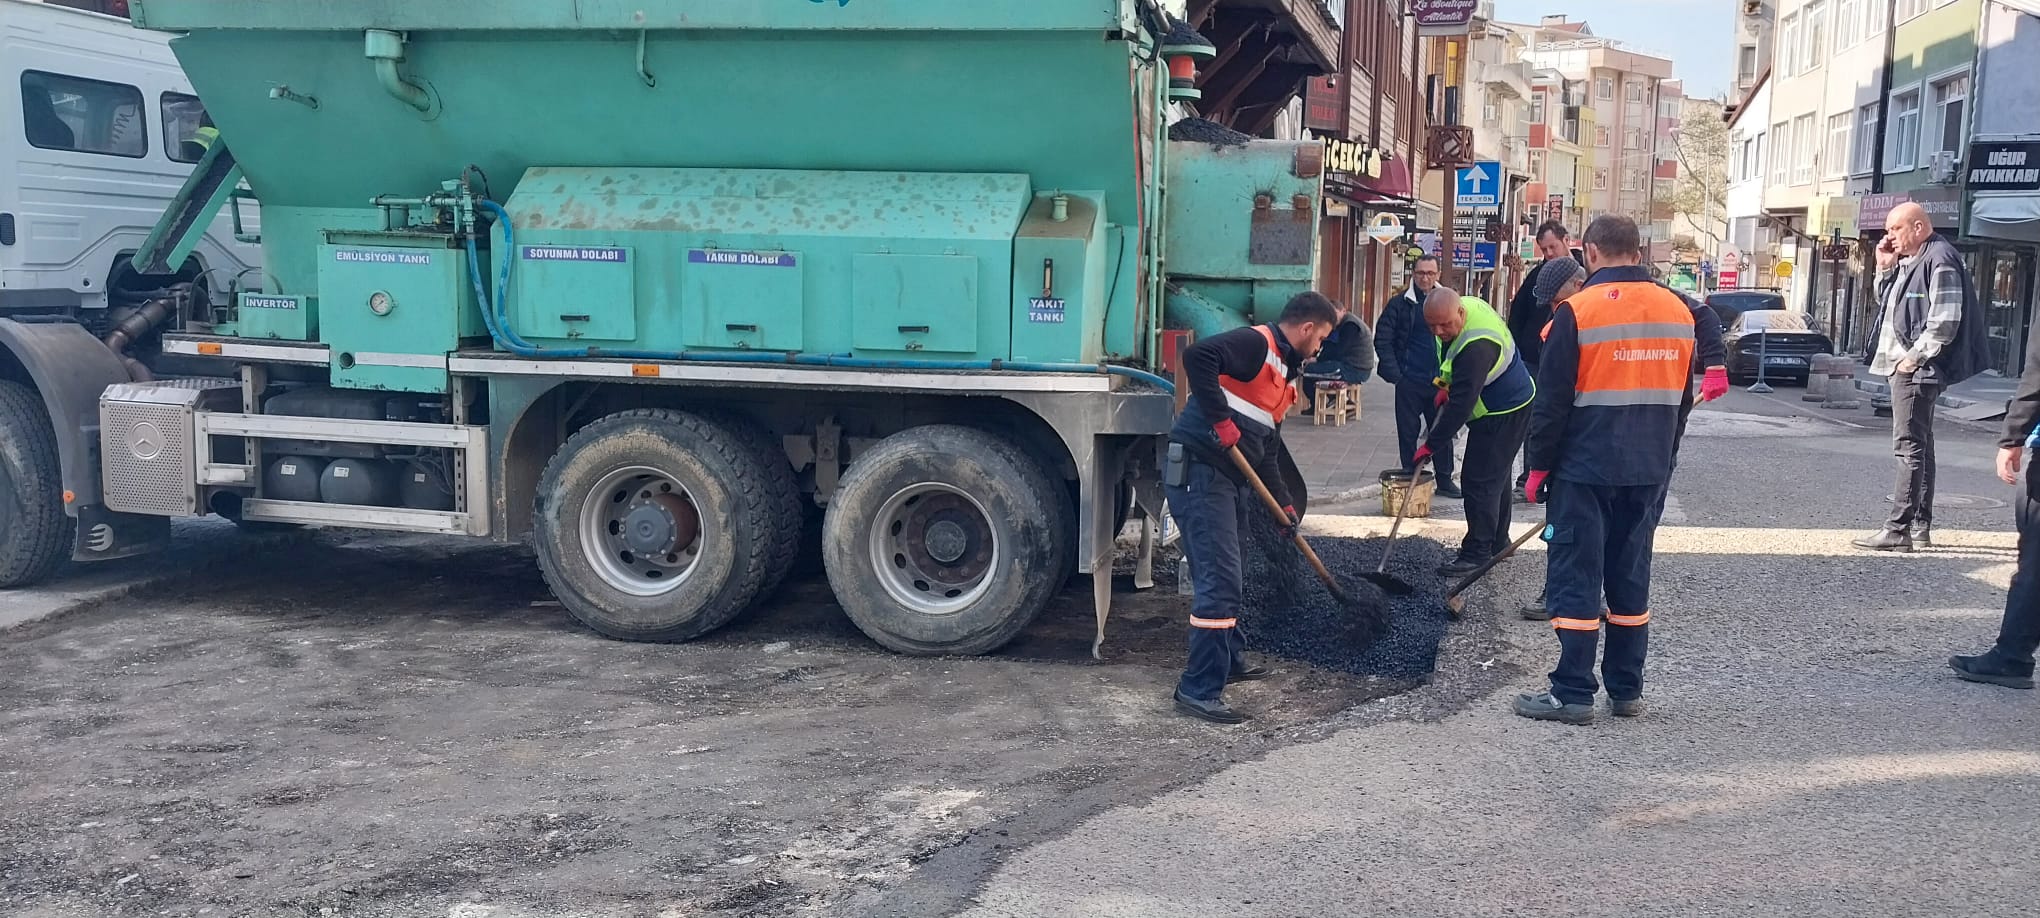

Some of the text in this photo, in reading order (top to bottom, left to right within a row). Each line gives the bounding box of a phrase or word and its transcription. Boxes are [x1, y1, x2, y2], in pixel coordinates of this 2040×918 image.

[1988, 147, 2027, 166] UĞUR
[1969, 168, 2040, 183] AYAKKABI
[398, 253, 431, 265] TANKI
[529, 248, 619, 261] SOYUNMA DOLABI
[706, 252, 779, 265] TAKIM DOLABI
[1030, 299, 1065, 309] YAKIT
[1029, 312, 1064, 322] TANKI
